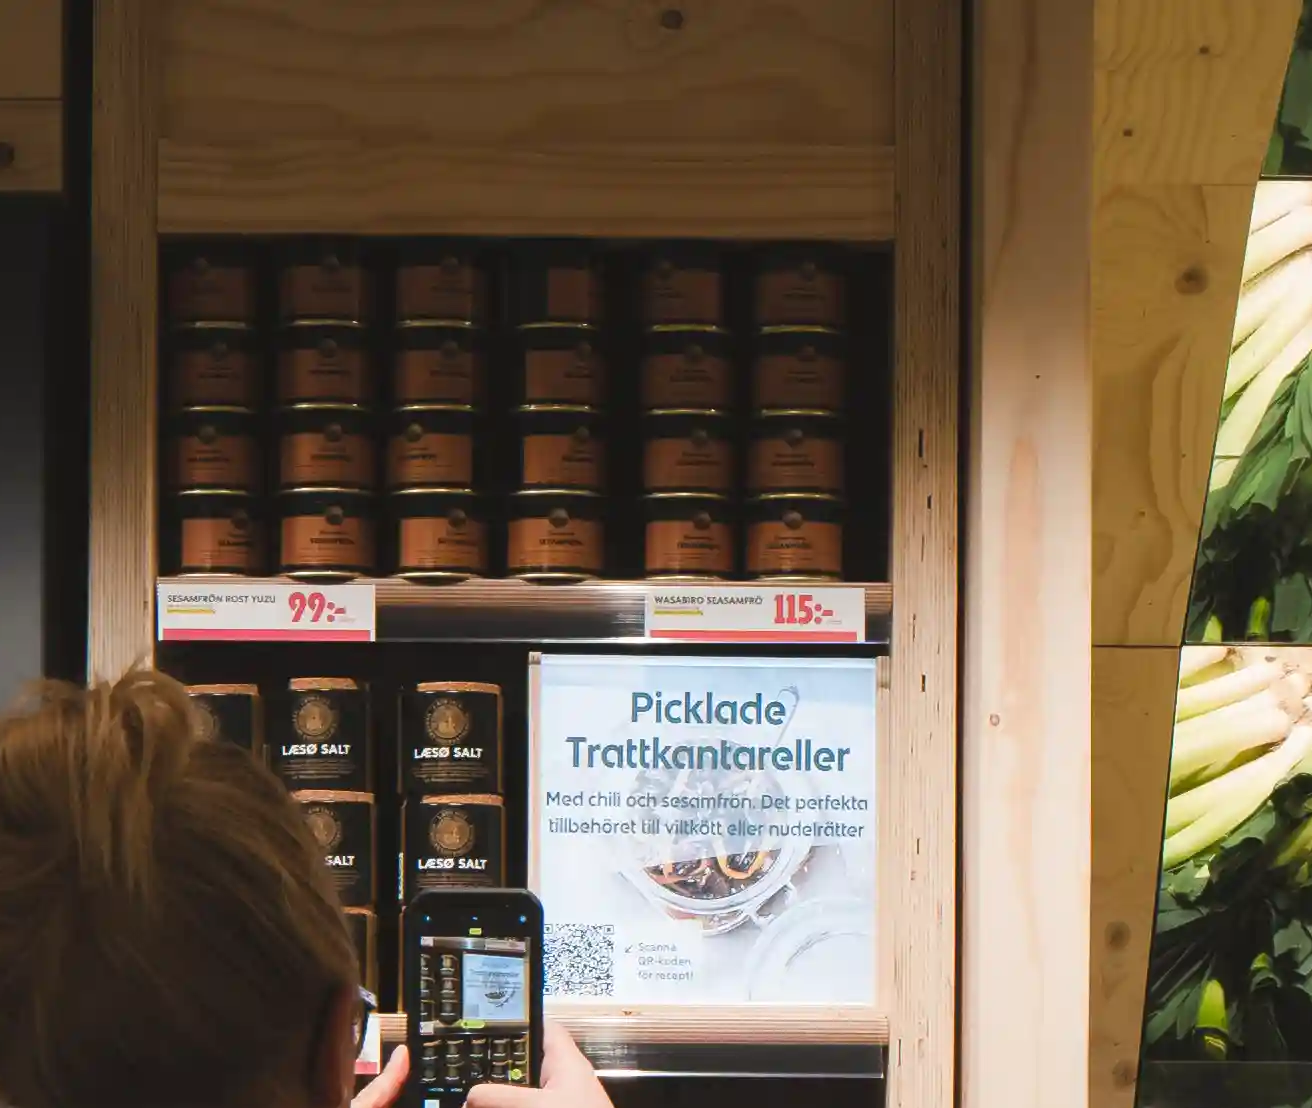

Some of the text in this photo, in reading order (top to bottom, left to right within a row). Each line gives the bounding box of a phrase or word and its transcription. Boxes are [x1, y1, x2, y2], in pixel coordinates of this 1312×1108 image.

[252, 595, 276, 604] YUZU
[288, 591, 347, 622] 99:-
[774, 594, 834, 625] 115:-
[631, 691, 786, 725] Picklade
[283, 744, 351, 756] LÆSØ SALT
[414, 747, 483, 759] LÆSØ SALT
[566, 736, 851, 772] Trattkantareller
[546, 791, 869, 813] Med chili och sesamfrön. Det perfekta
[549, 817, 865, 838] tillbehöret till viltkött eller nudelrätter
[325, 855, 355, 866] SALT
[418, 859, 488, 870] LÆSØ SALT
[638, 942, 677, 952] Scanna
[638, 955, 691, 966] QR-koden
